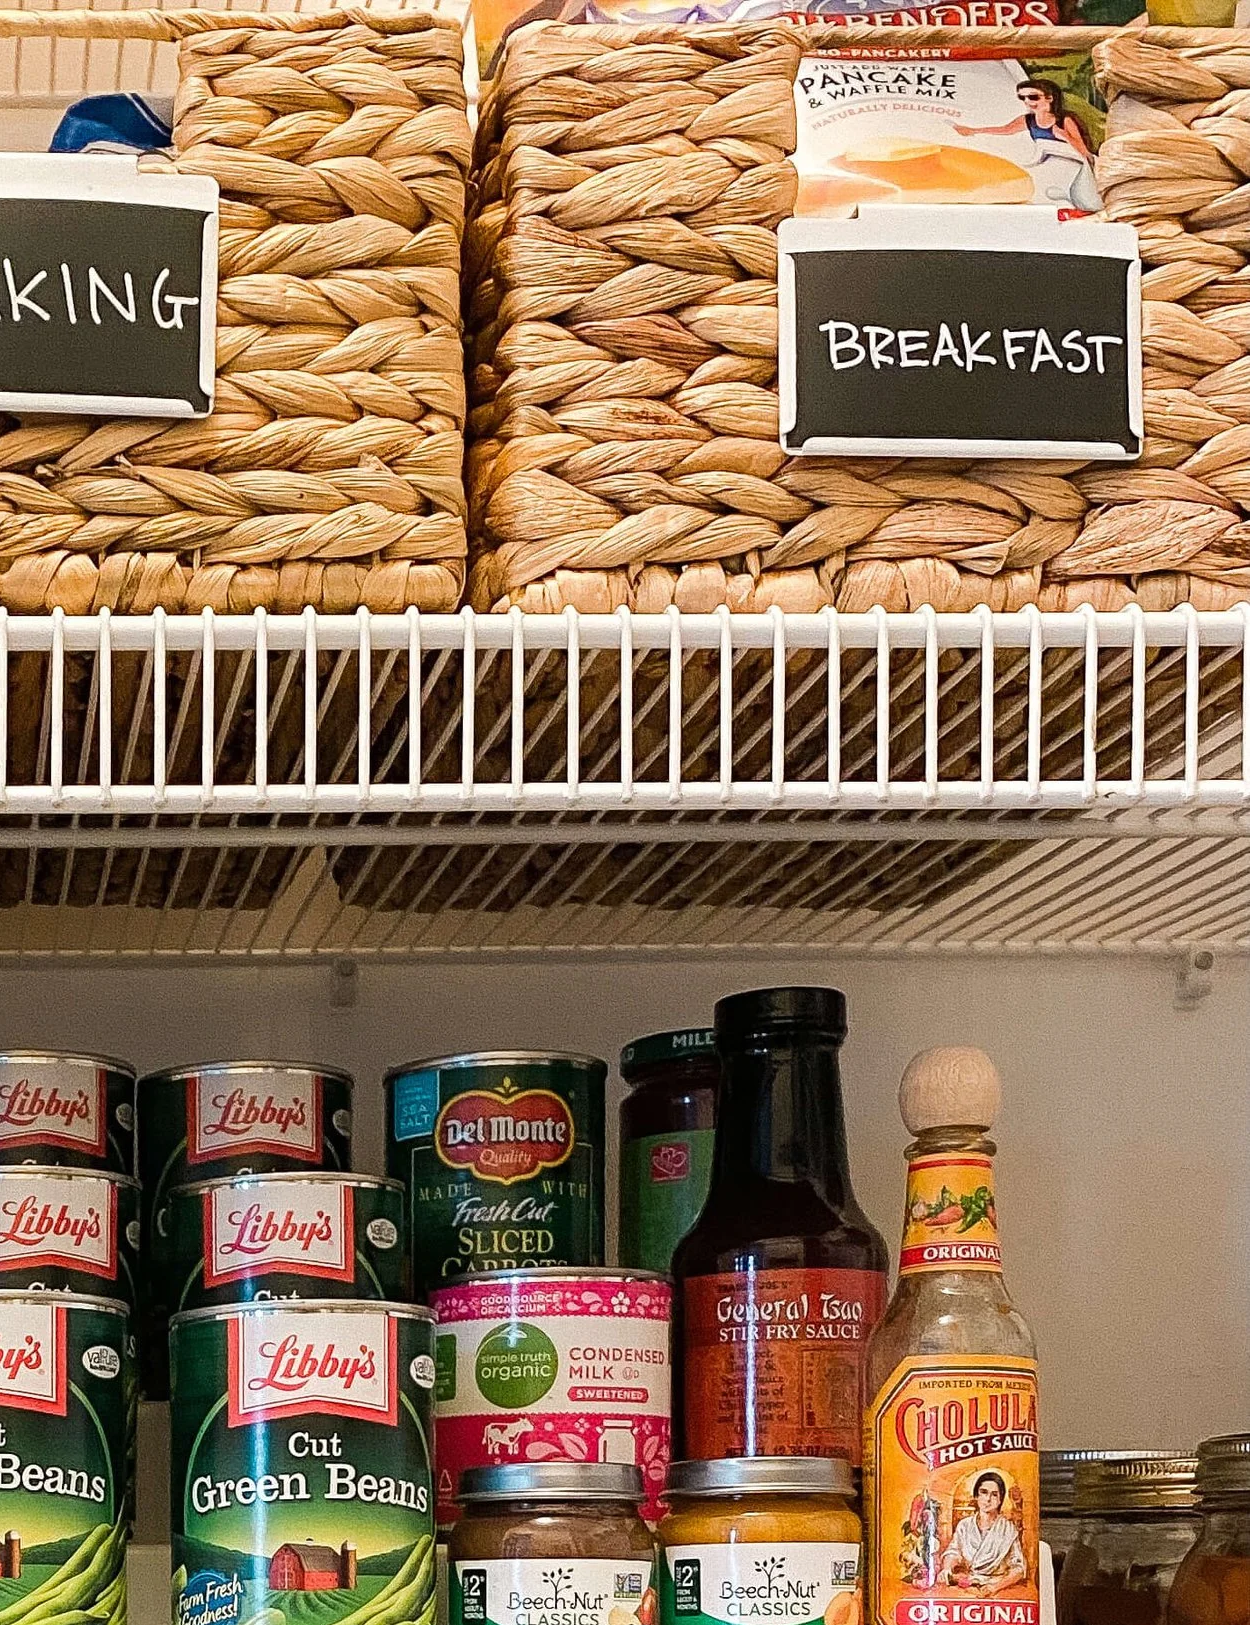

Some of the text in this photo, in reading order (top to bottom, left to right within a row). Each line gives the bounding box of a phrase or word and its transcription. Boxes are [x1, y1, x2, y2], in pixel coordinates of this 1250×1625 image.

[799, 71, 956, 95] PANCAKE
[827, 84, 907, 100] WAFFLE
[915, 87, 957, 100] MIX
[812, 103, 962, 129] NATURALLY DELICIOUS
[818, 320, 1124, 376] BREAKFAST
[204, 1088, 306, 1136] Libby's
[446, 1117, 566, 1145] Del Monte
[480, 1149, 531, 1166] Quality
[419, 1180, 586, 1200] MADE WITH
[452, 1197, 557, 1227] Fresh Cut
[219, 1204, 331, 1254] Libby's
[458, 1228, 553, 1254] SLICED
[923, 1245, 999, 1261] ORIGINAL
[481, 1296, 512, 1306] GOOD
[717, 1293, 808, 1323] General
[720, 1324, 860, 1342] STIR FRY SAUCE
[248, 1334, 376, 1391] Libby's
[481, 1352, 552, 1366] simple truth
[569, 1347, 665, 1366] CONDENSED
[481, 1363, 552, 1381] organic
[569, 1365, 614, 1380] MILK
[576, 1389, 644, 1400] SWEETENED
[919, 1380, 972, 1389] IMPORTED
[895, 1394, 1037, 1464] CHOLULA
[288, 1432, 341, 1457] Cut
[940, 1434, 1035, 1464] HOT SAUCE
[192, 1463, 427, 1514] Green Beans
[179, 1573, 244, 1612] Farm Fresh
[719, 1580, 816, 1599] Beech-Nut
[507, 1592, 604, 1610] Beech-Nut
[727, 1602, 811, 1616] CLASSICS
[908, 1603, 1035, 1624] ORIGINAL
